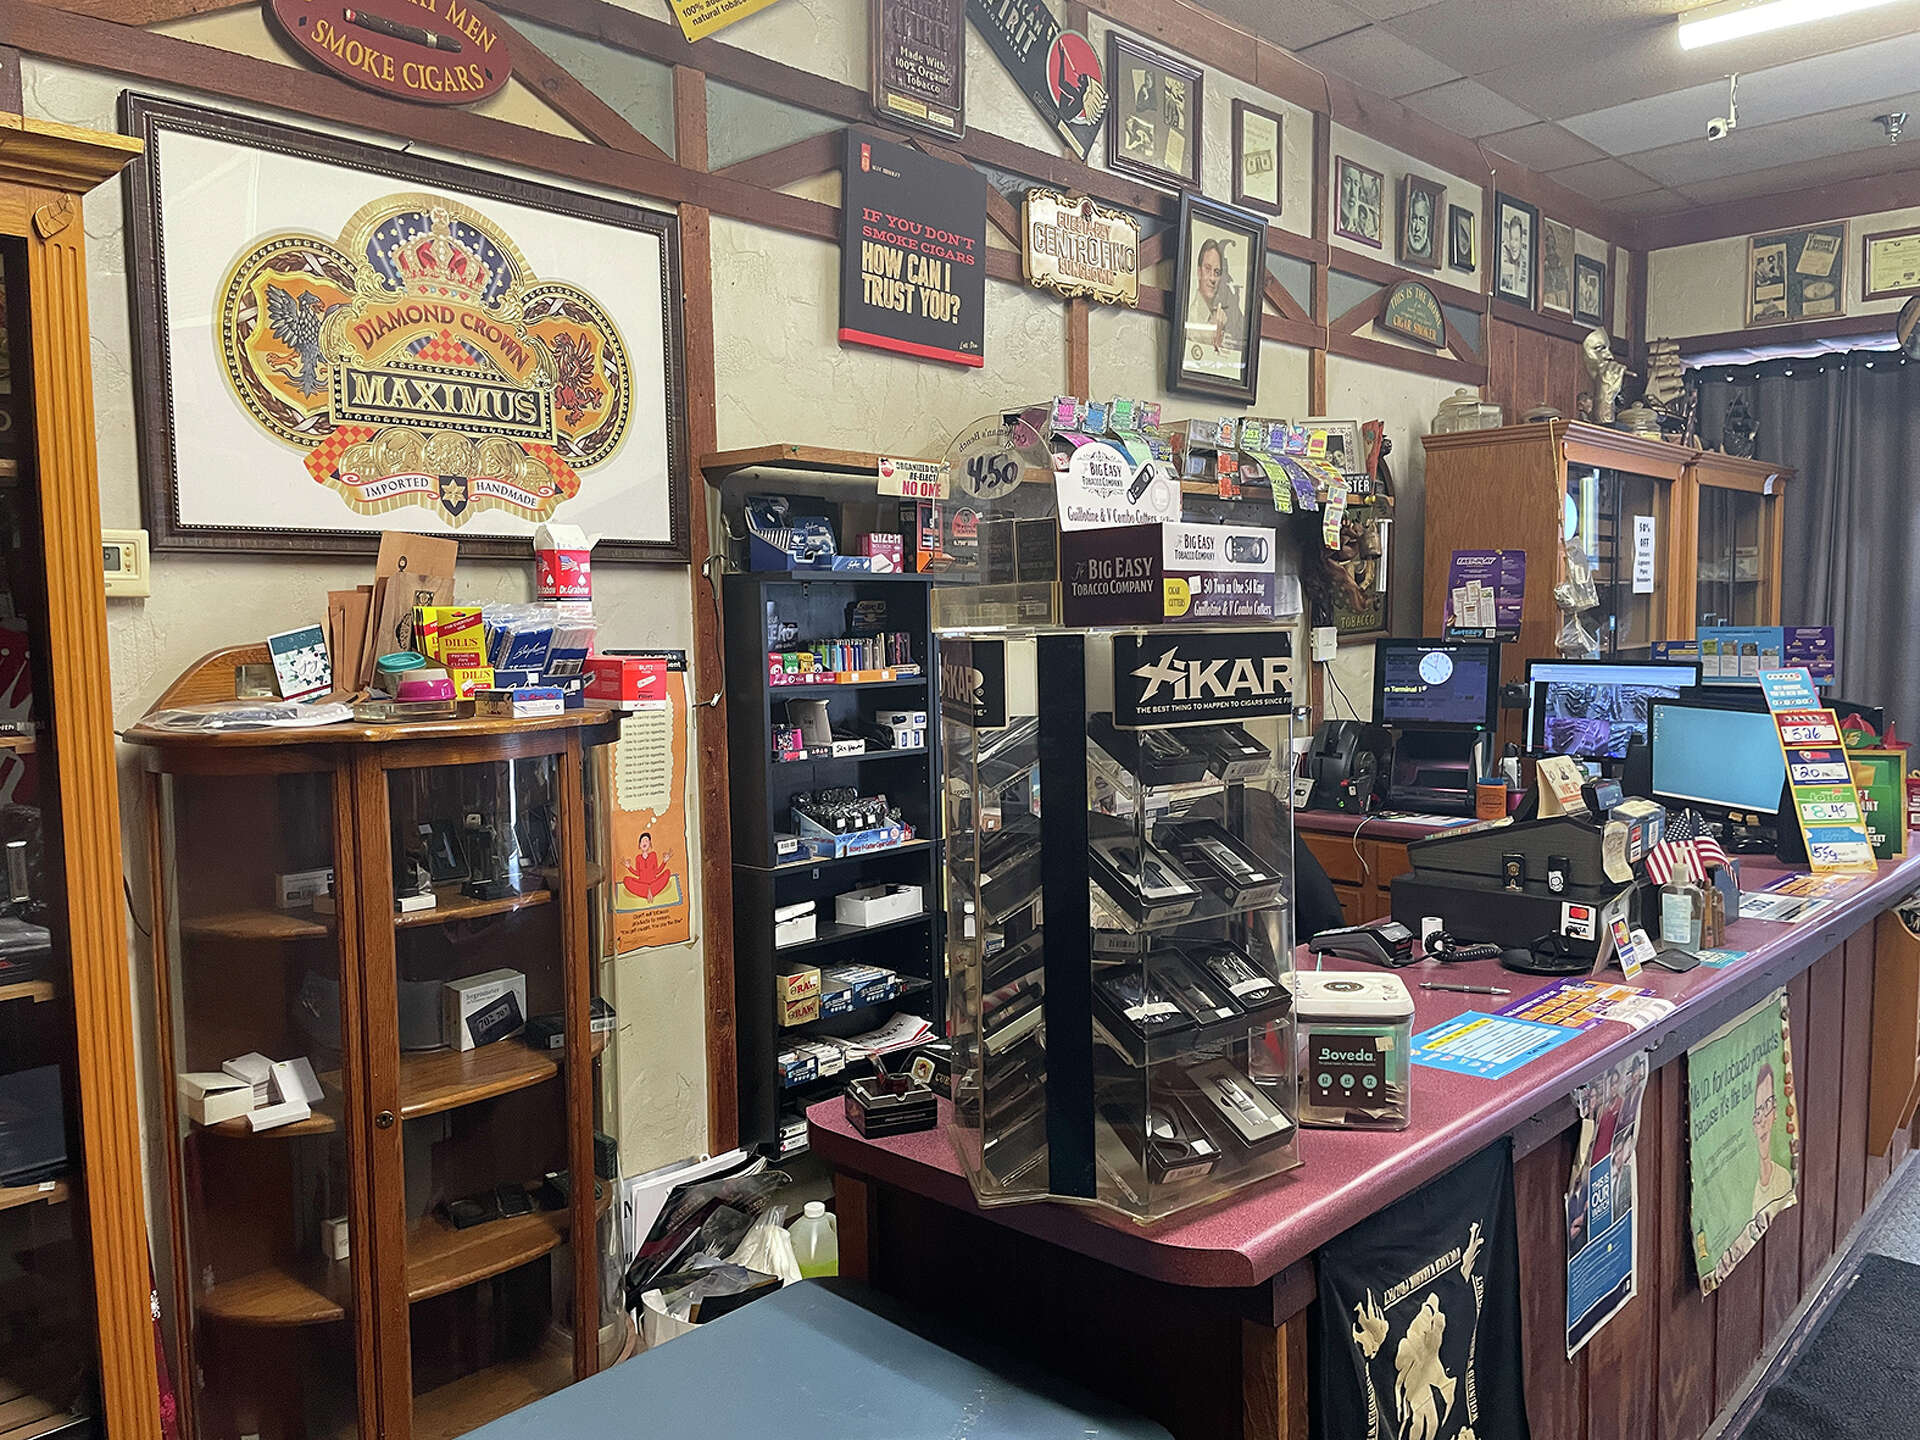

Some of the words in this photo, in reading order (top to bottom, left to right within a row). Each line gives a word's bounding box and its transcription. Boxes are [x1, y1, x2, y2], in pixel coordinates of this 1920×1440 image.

[682, 2, 705, 18] 100%
[692, 8, 720, 26] natural
[445, 0, 497, 53] MEN
[311, 19, 395, 82] SMOKE
[402, 61, 485, 93] CIGARS
[900, 46, 924, 64] Made
[926, 55, 946, 71] With
[895, 57, 916, 73] 100%
[918, 65, 951, 86] Organic
[906, 73, 941, 94] Tobacco
[862, 207, 883, 223] IF
[885, 214, 923, 235] YOU
[924, 226, 976, 251] DON'T
[862, 225, 918, 251] SMOKE
[920, 242, 975, 266] CIGARS
[1033, 221, 1100, 266] CENTRO
[1101, 239, 1136, 275] FINO
[862, 240, 904, 280] HOW
[907, 253, 941, 290] CAN
[944, 262, 951, 293] I
[861, 273, 915, 314] TRUST
[918, 286, 961, 324] YOU?
[353, 304, 456, 351] DIAMOND
[460, 310, 530, 373] CROWN
[351, 372, 538, 425] MAXIMUS
[1089, 461, 1102, 476] BIG
[1103, 462, 1122, 478] EASY
[365, 477, 430, 498] IMPORTED
[476, 481, 537, 508] HANDMADE
[902, 480, 918, 496] NO
[920, 482, 942, 497] ONE
[1347, 478, 1370, 493] STER
[1113, 509, 1135, 524] Combo
[1184, 533, 1197, 549] BIG
[1198, 534, 1215, 550] EASY
[1088, 557, 1113, 580] BIG
[1114, 555, 1153, 580] EASY
[1071, 581, 1109, 597] TOBACCO
[1110, 579, 1154, 595] COMPANY
[1204, 578, 1212, 594] 50
[1213, 578, 1226, 594] Two
[1225, 578, 1232, 594] in
[1232, 578, 1244, 594] One
[1234, 600, 1253, 616] Combo
[1340, 614, 1375, 629] TOBACCO
[1136, 706, 1152, 714] THE
[1152, 705, 1170, 713] BEST
[1171, 703, 1192, 712] THING
[1203, 701, 1230, 709] HAPPEN
[1240, 699, 1263, 707] CIGARS
[1264, 697, 1283, 705] SINCE
[1791, 727, 1821, 741] 526
[1799, 766, 1820, 778] 20
[1810, 803, 1847, 818] 8.45
[796, 980, 816, 994] RA
[1318, 1047, 1374, 1062] Boveda
[1724, 1051, 1751, 1088] tobacco
[1591, 1183, 1610, 1208] OUR
